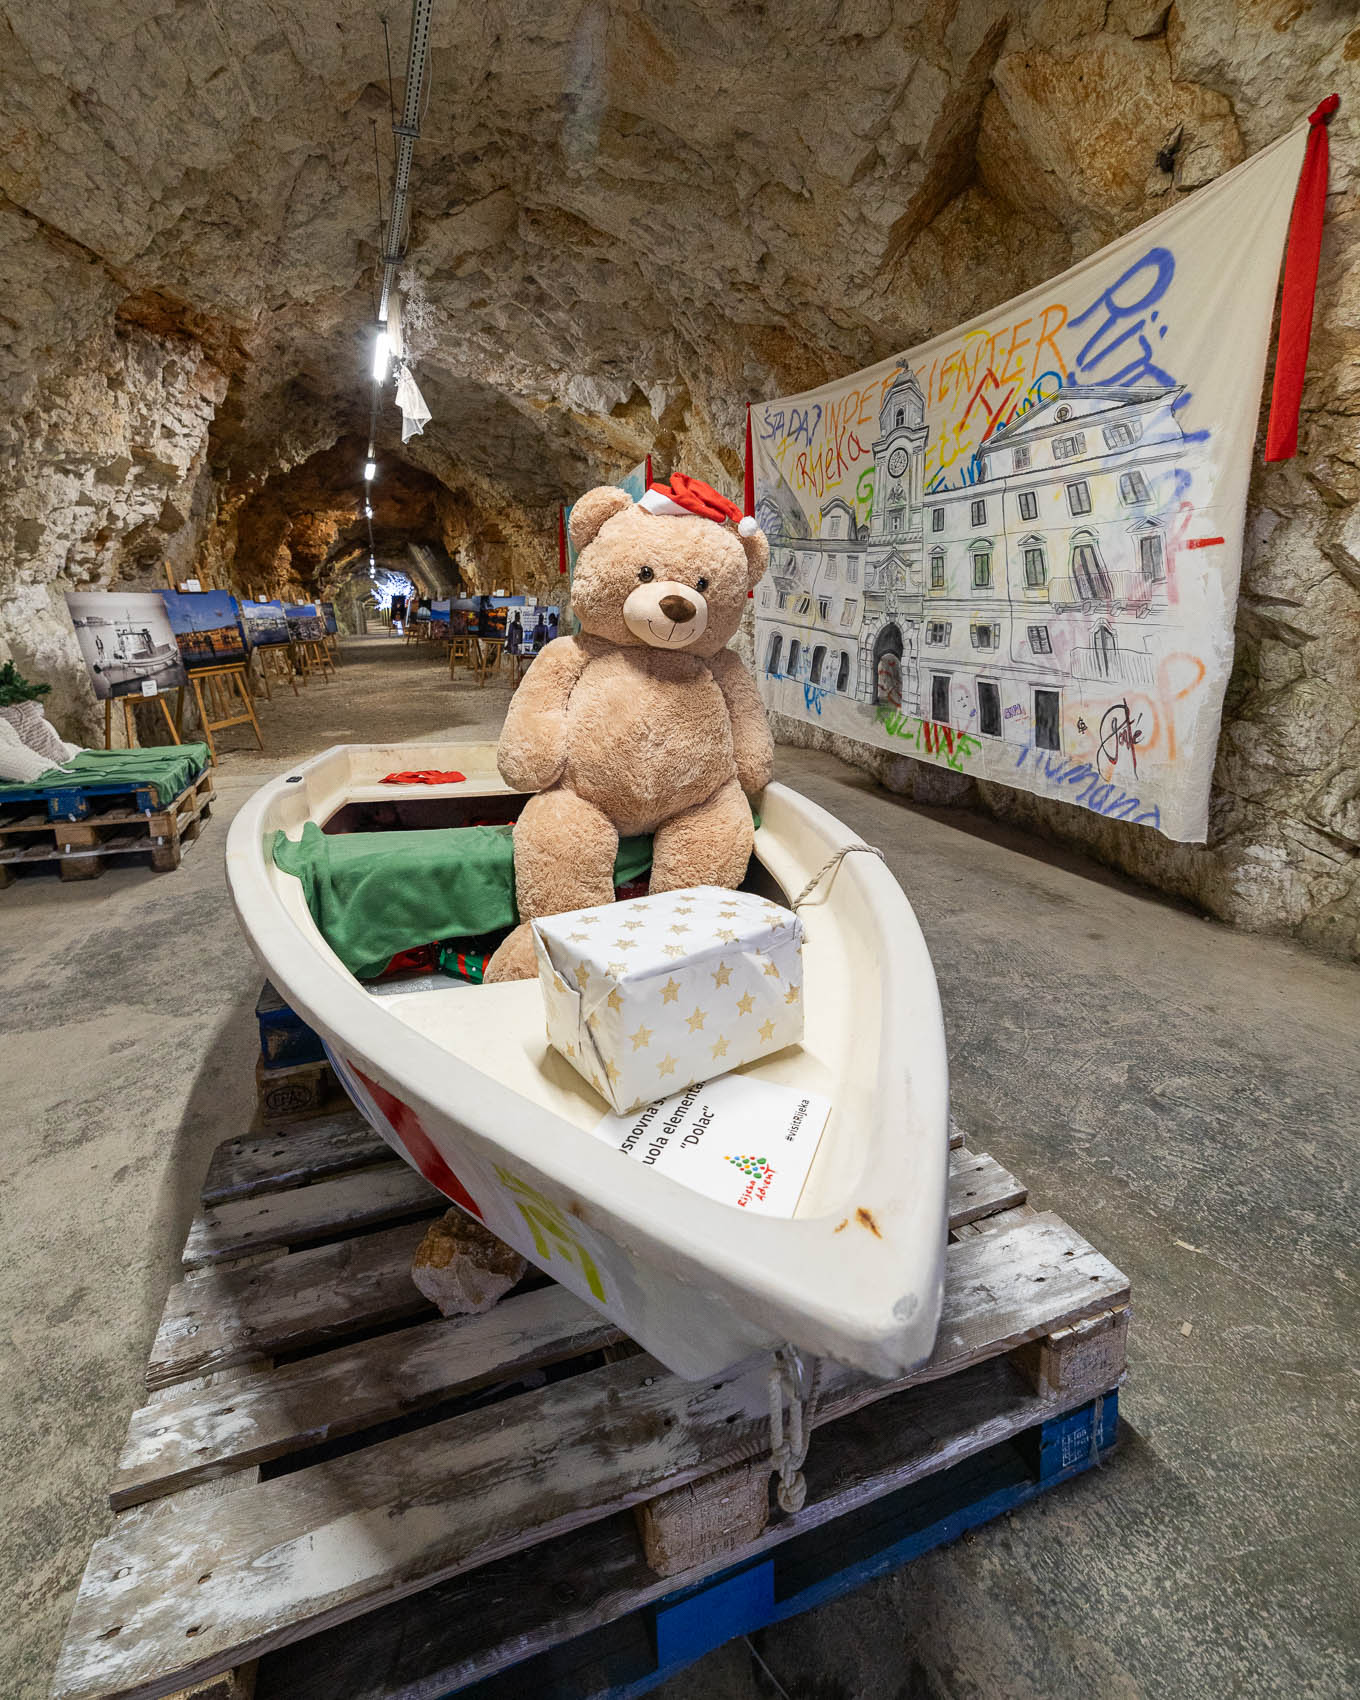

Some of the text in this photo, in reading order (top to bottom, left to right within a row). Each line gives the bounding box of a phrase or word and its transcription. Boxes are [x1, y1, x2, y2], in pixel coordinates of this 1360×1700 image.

[680, 1105, 715, 1149] "Dolac"
[785, 1099, 810, 1141] #visitRijeka
[737, 1180, 757, 1207] Rijeka
